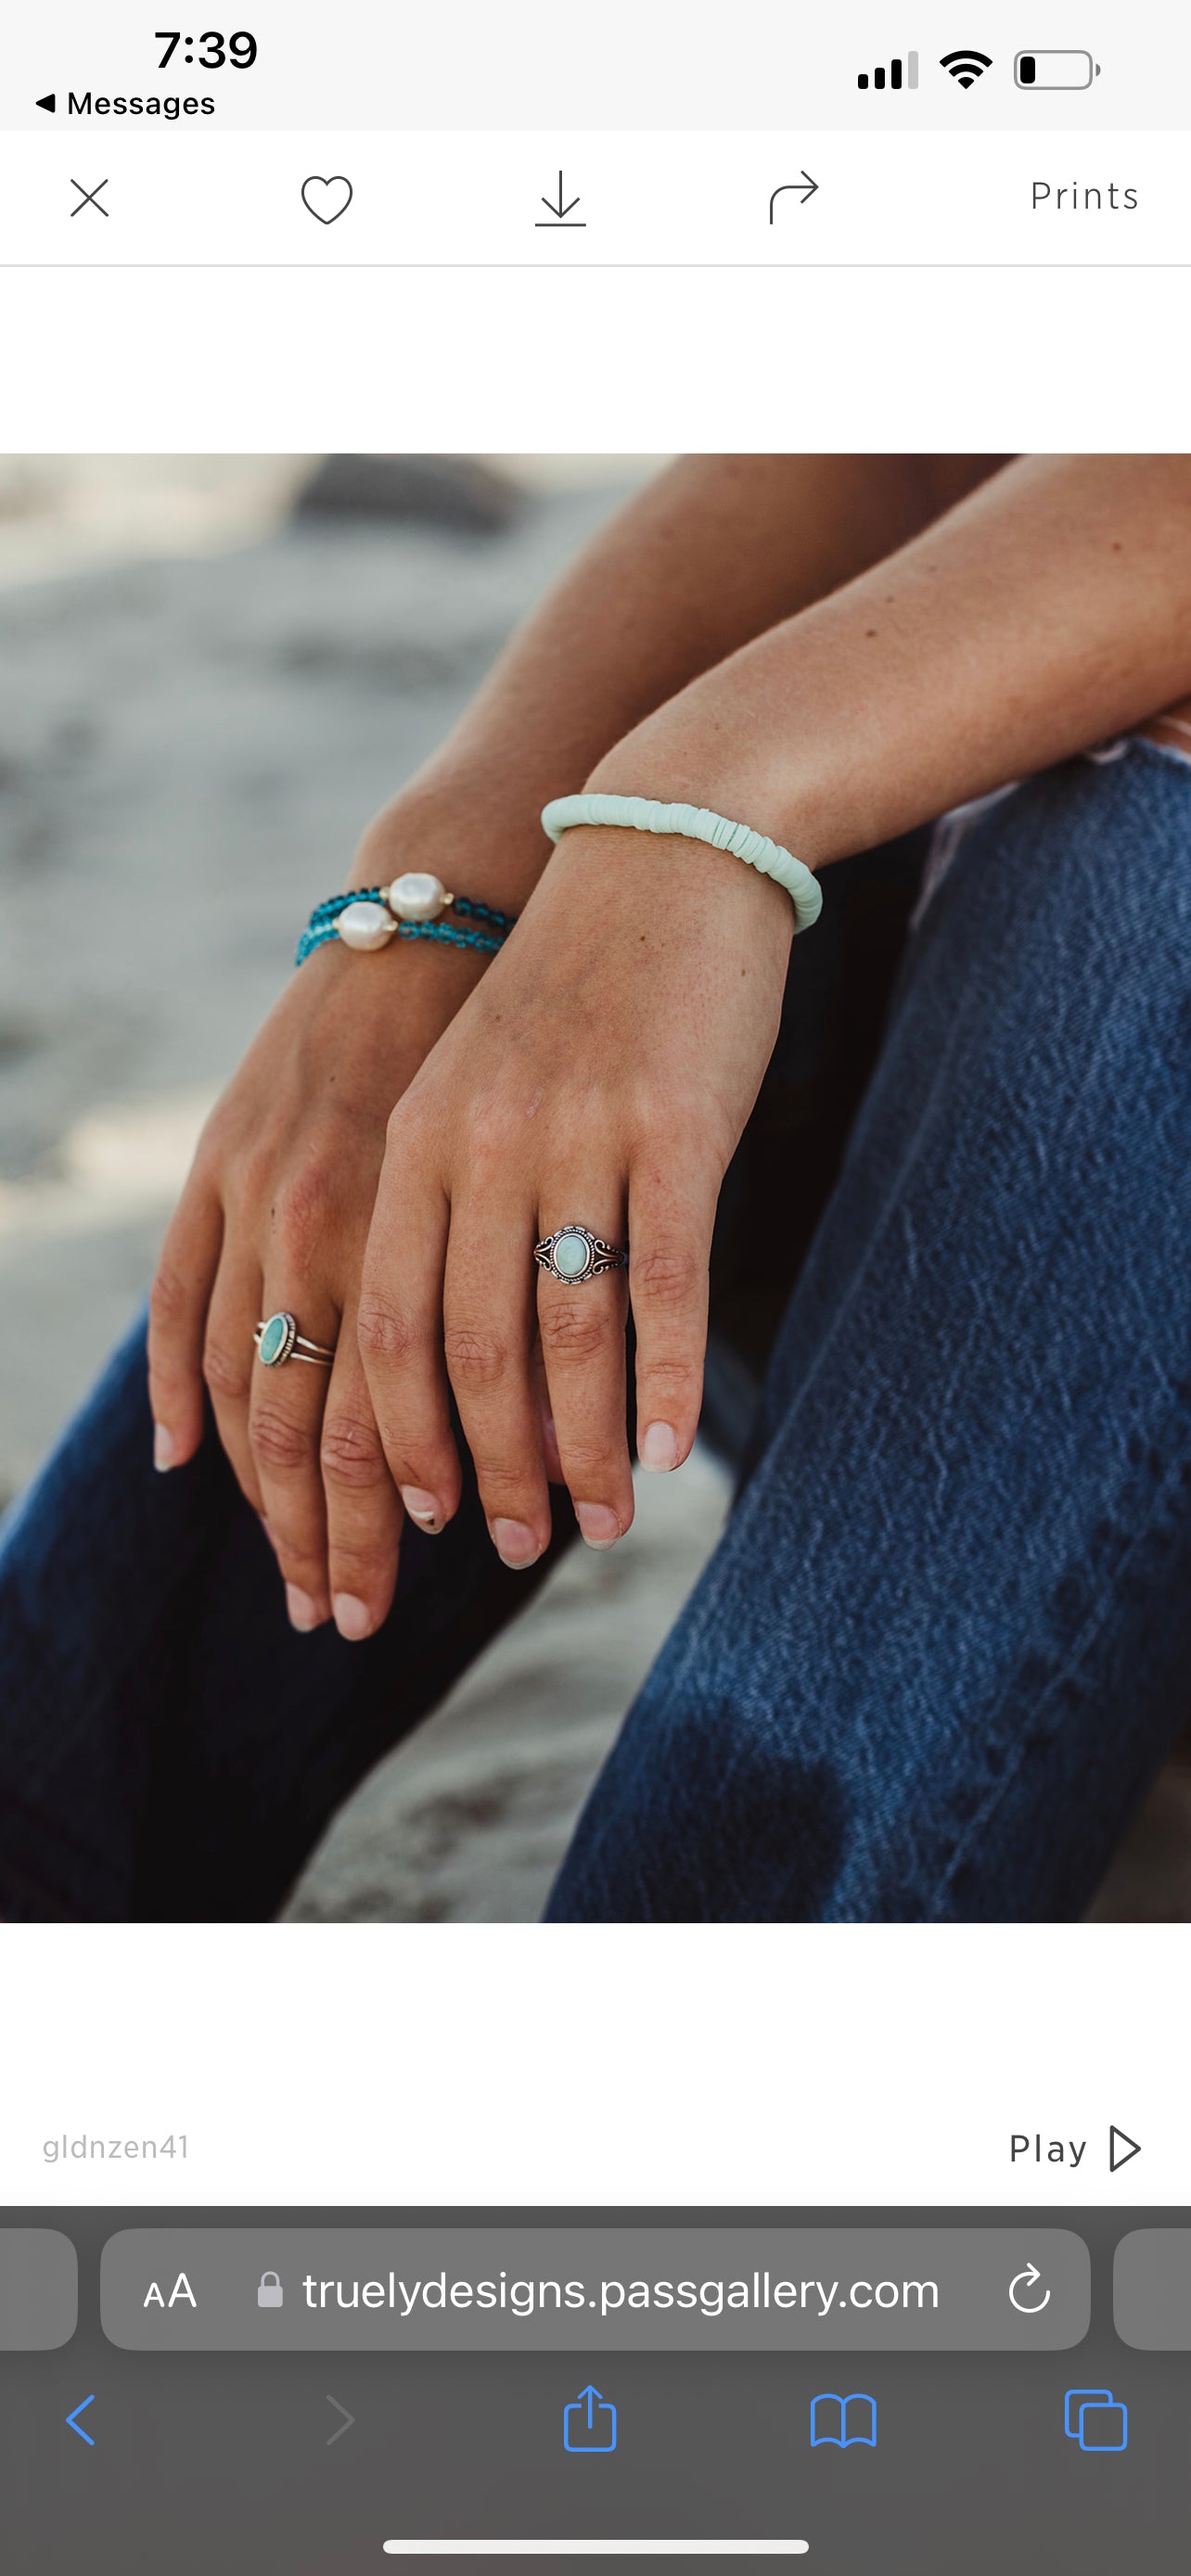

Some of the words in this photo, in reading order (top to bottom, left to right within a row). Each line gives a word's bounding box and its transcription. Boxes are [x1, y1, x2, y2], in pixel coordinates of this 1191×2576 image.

[154, 31, 258, 70] 7:39
[68, 91, 215, 121] Messages
[1031, 181, 1139, 210] Prints
[42, 2133, 189, 2164] gldnzen41
[1009, 2133, 1088, 2168] Play
[301, 2271, 940, 2317] truelydesigns.passgallery.com
